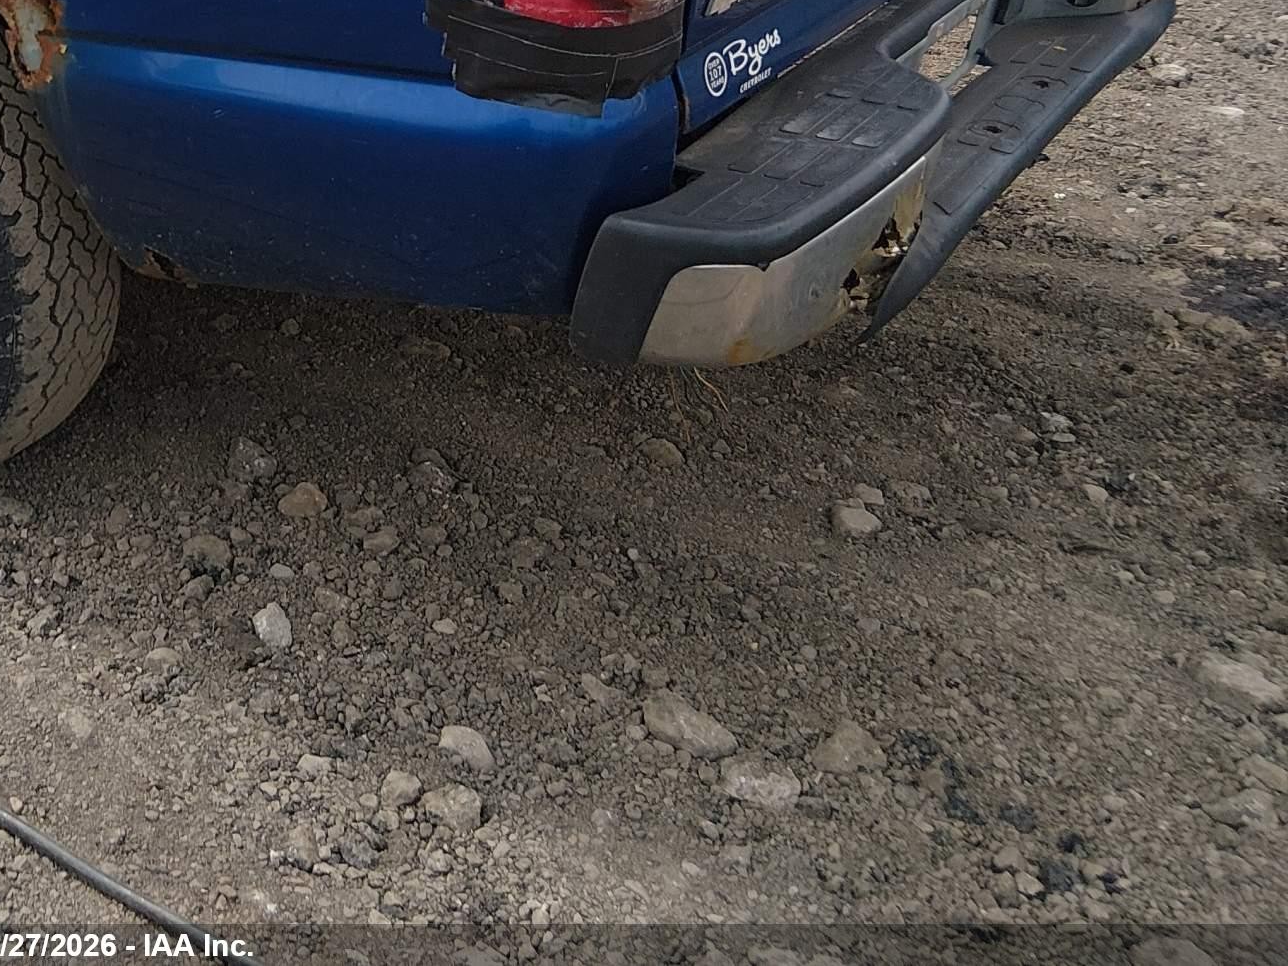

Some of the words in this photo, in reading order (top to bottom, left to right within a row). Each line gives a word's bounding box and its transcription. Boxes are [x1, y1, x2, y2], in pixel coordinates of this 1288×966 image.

[722, 28, 781, 76] Byers
[709, 65, 723, 81] 107
[739, 67, 772, 94] CHEVROLET
